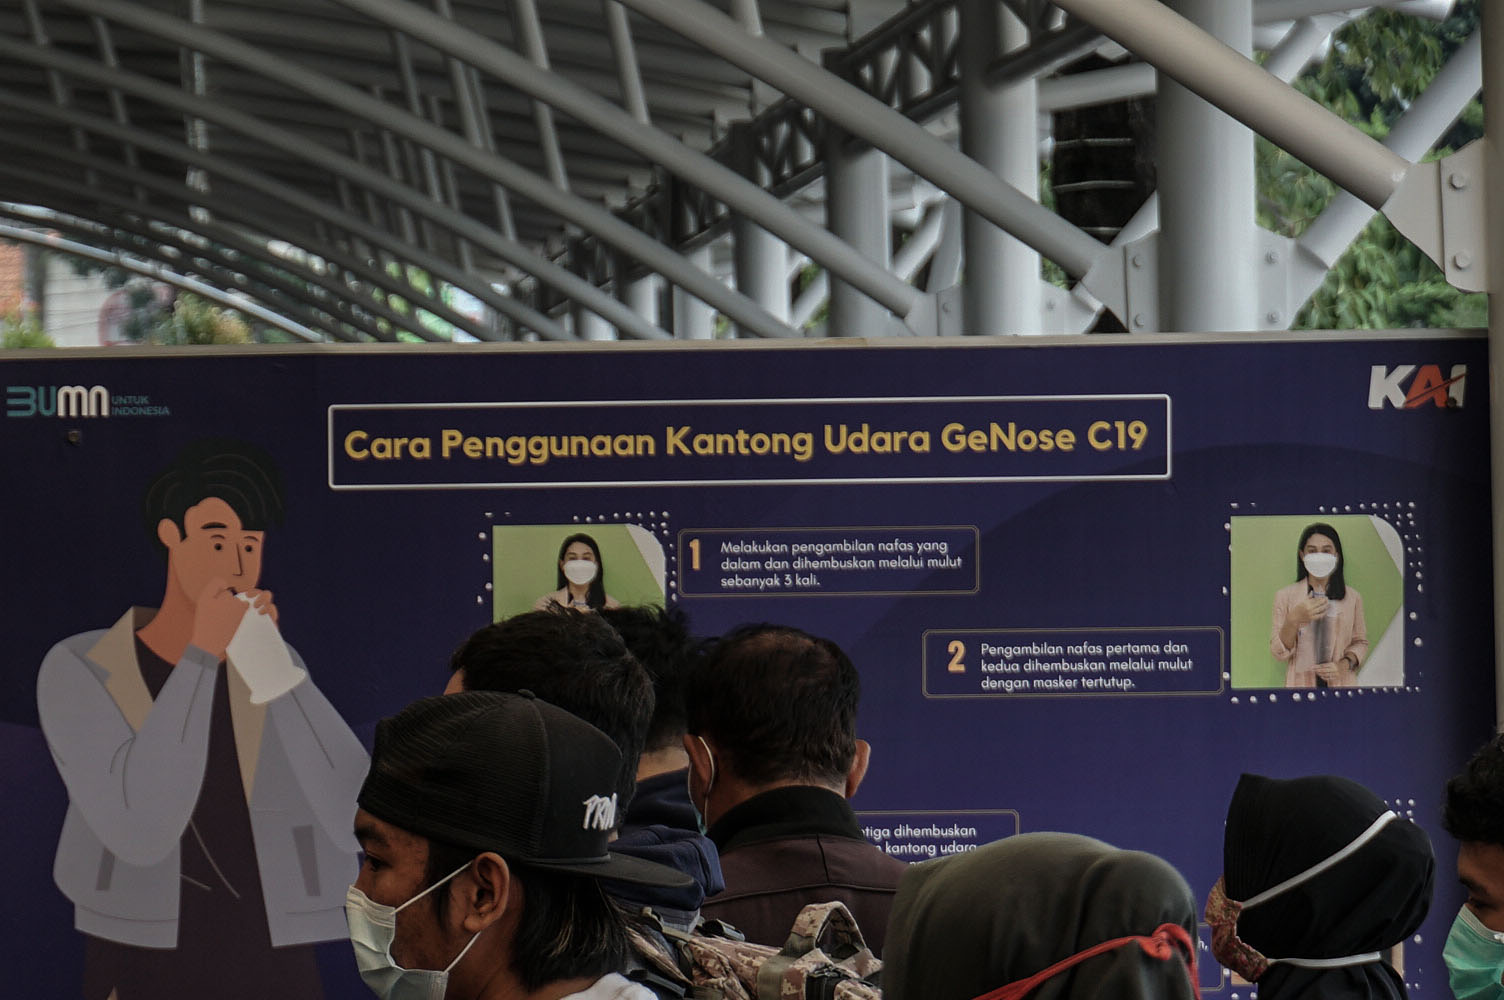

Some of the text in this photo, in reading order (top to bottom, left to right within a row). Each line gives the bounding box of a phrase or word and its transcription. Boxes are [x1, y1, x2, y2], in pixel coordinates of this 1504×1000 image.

[1368, 364, 1467, 409] KAI
[112, 396, 148, 405] UNTUK
[112, 407, 170, 416] INDONESIA
[344, 420, 1148, 465] Cara Penggunaan Kantong Udara GeNose C19
[689, 538, 700, 570] 1
[720, 538, 948, 556] Melakukan pengambilan nafas yang
[720, 556, 963, 570] dalam dan dihembuskan melalui mulut
[720, 573, 821, 589] sebanyak 3 kali.
[947, 640, 965, 673] 2
[981, 640, 1188, 659] Pengambilan nafas pertama dan
[981, 657, 1193, 672] kedua dihembuskan melalui mulut
[980, 676, 1135, 692] dengan masker tertutup.
[861, 823, 976, 841] tiga dihembuskan
[885, 840, 936, 858] kantong
